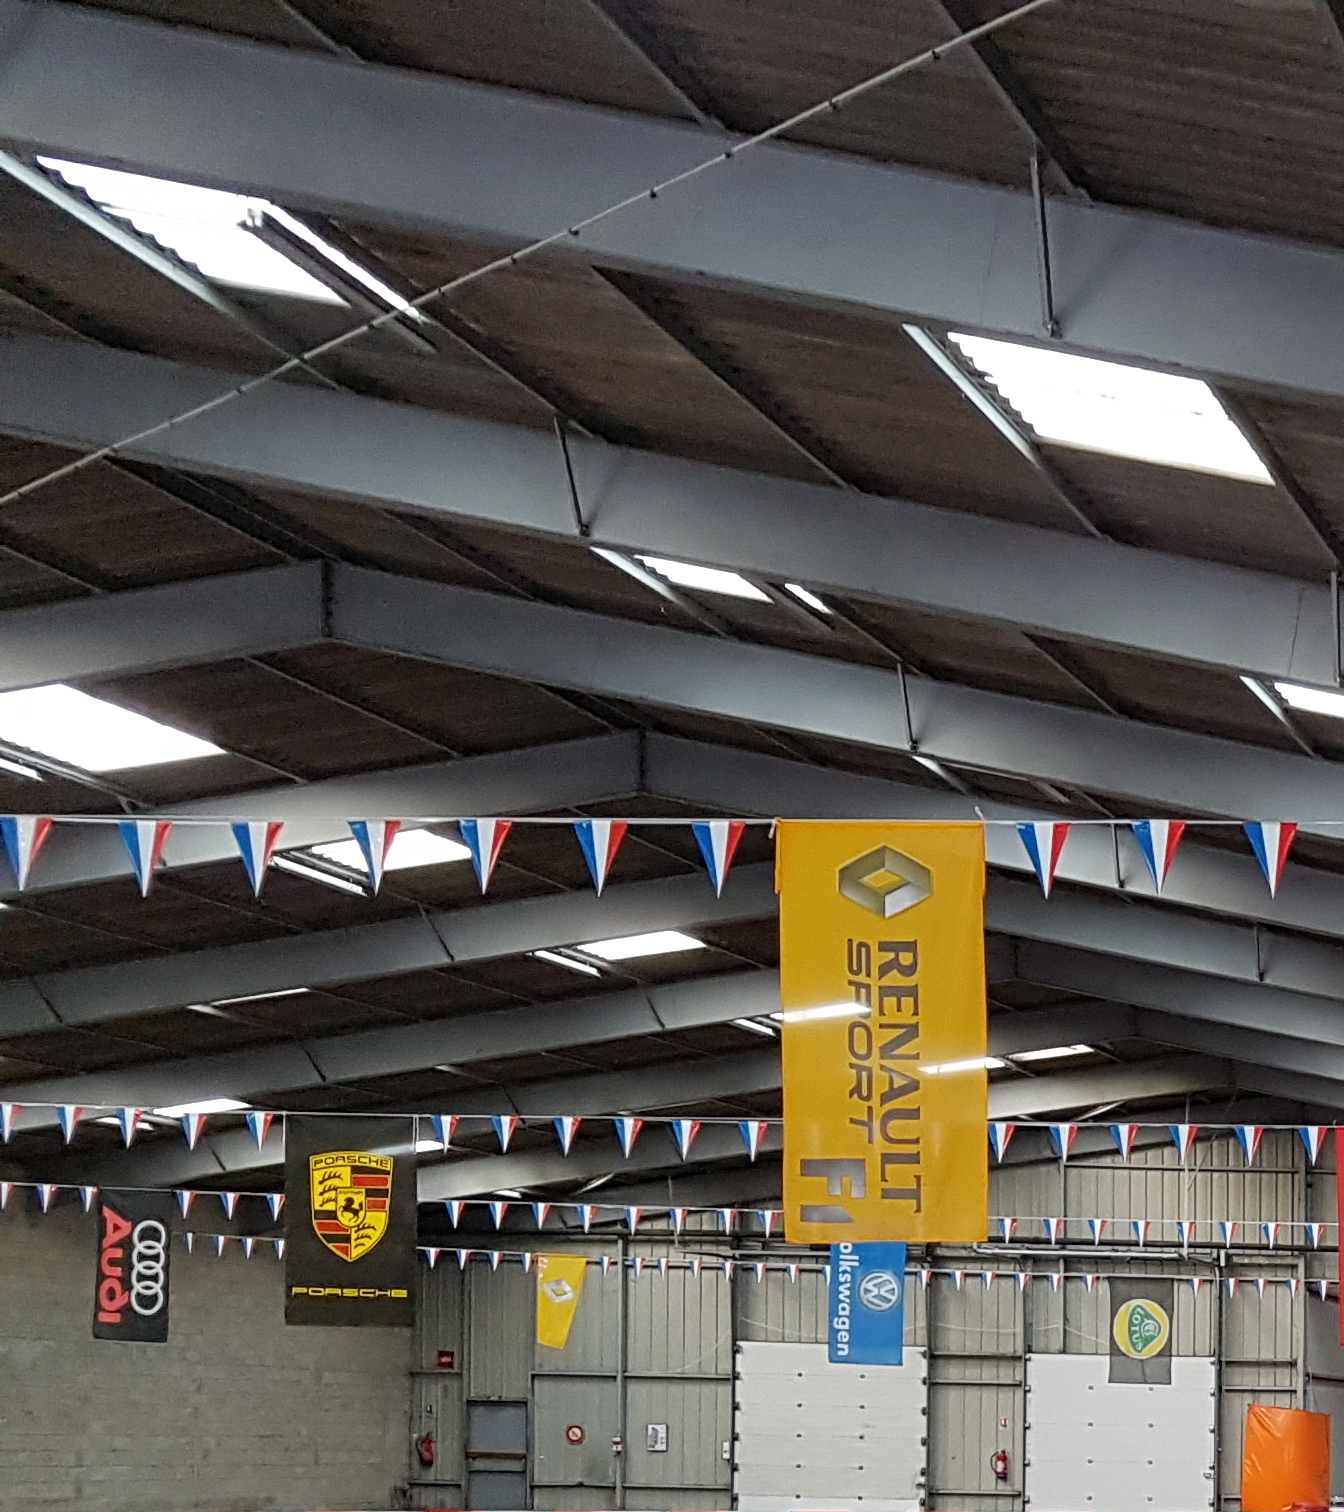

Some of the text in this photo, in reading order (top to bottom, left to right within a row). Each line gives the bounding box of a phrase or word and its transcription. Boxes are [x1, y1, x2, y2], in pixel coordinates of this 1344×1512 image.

[846, 938, 873, 1144] SPORT
[877, 939, 922, 1213] RENAULT
[313, 1155, 390, 1168] PORSCHE
[800, 1158, 866, 1223] F1
[292, 1286, 408, 1298] PORSCHE
[833, 1242, 860, 1356] olkswagen
[1131, 1307, 1145, 1351] LOTUS
